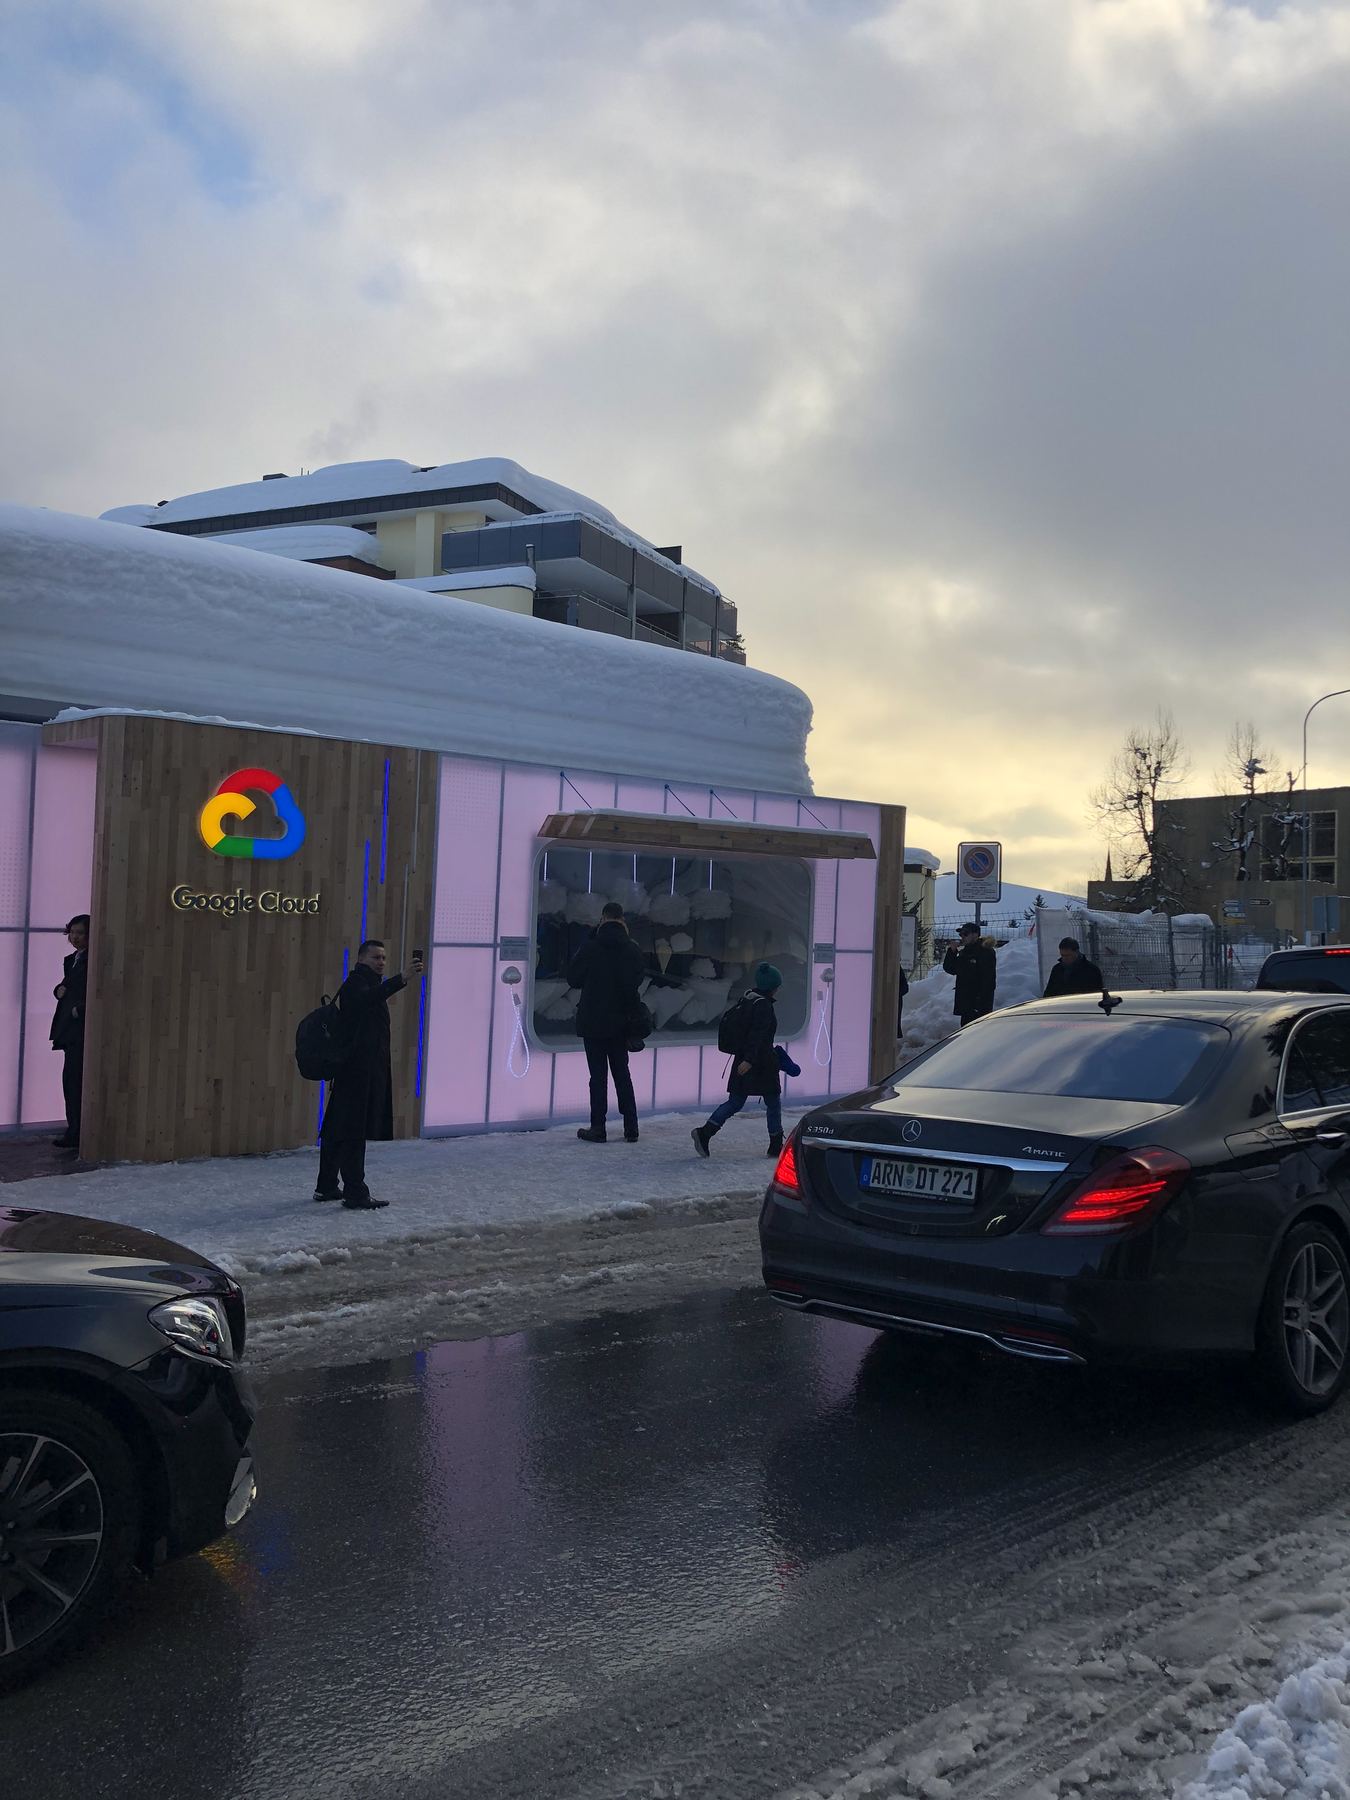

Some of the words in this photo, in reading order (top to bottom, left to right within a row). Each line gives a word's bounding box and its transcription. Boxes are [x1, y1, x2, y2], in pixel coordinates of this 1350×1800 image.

[171, 884, 256, 917] Google
[258, 890, 321, 914] Cloud
[1022, 1146, 1066, 1158] 4MATIC
[871, 1162, 904, 1187] ARN
[915, 1167, 939, 1191] DT
[941, 1169, 973, 1196] 271
